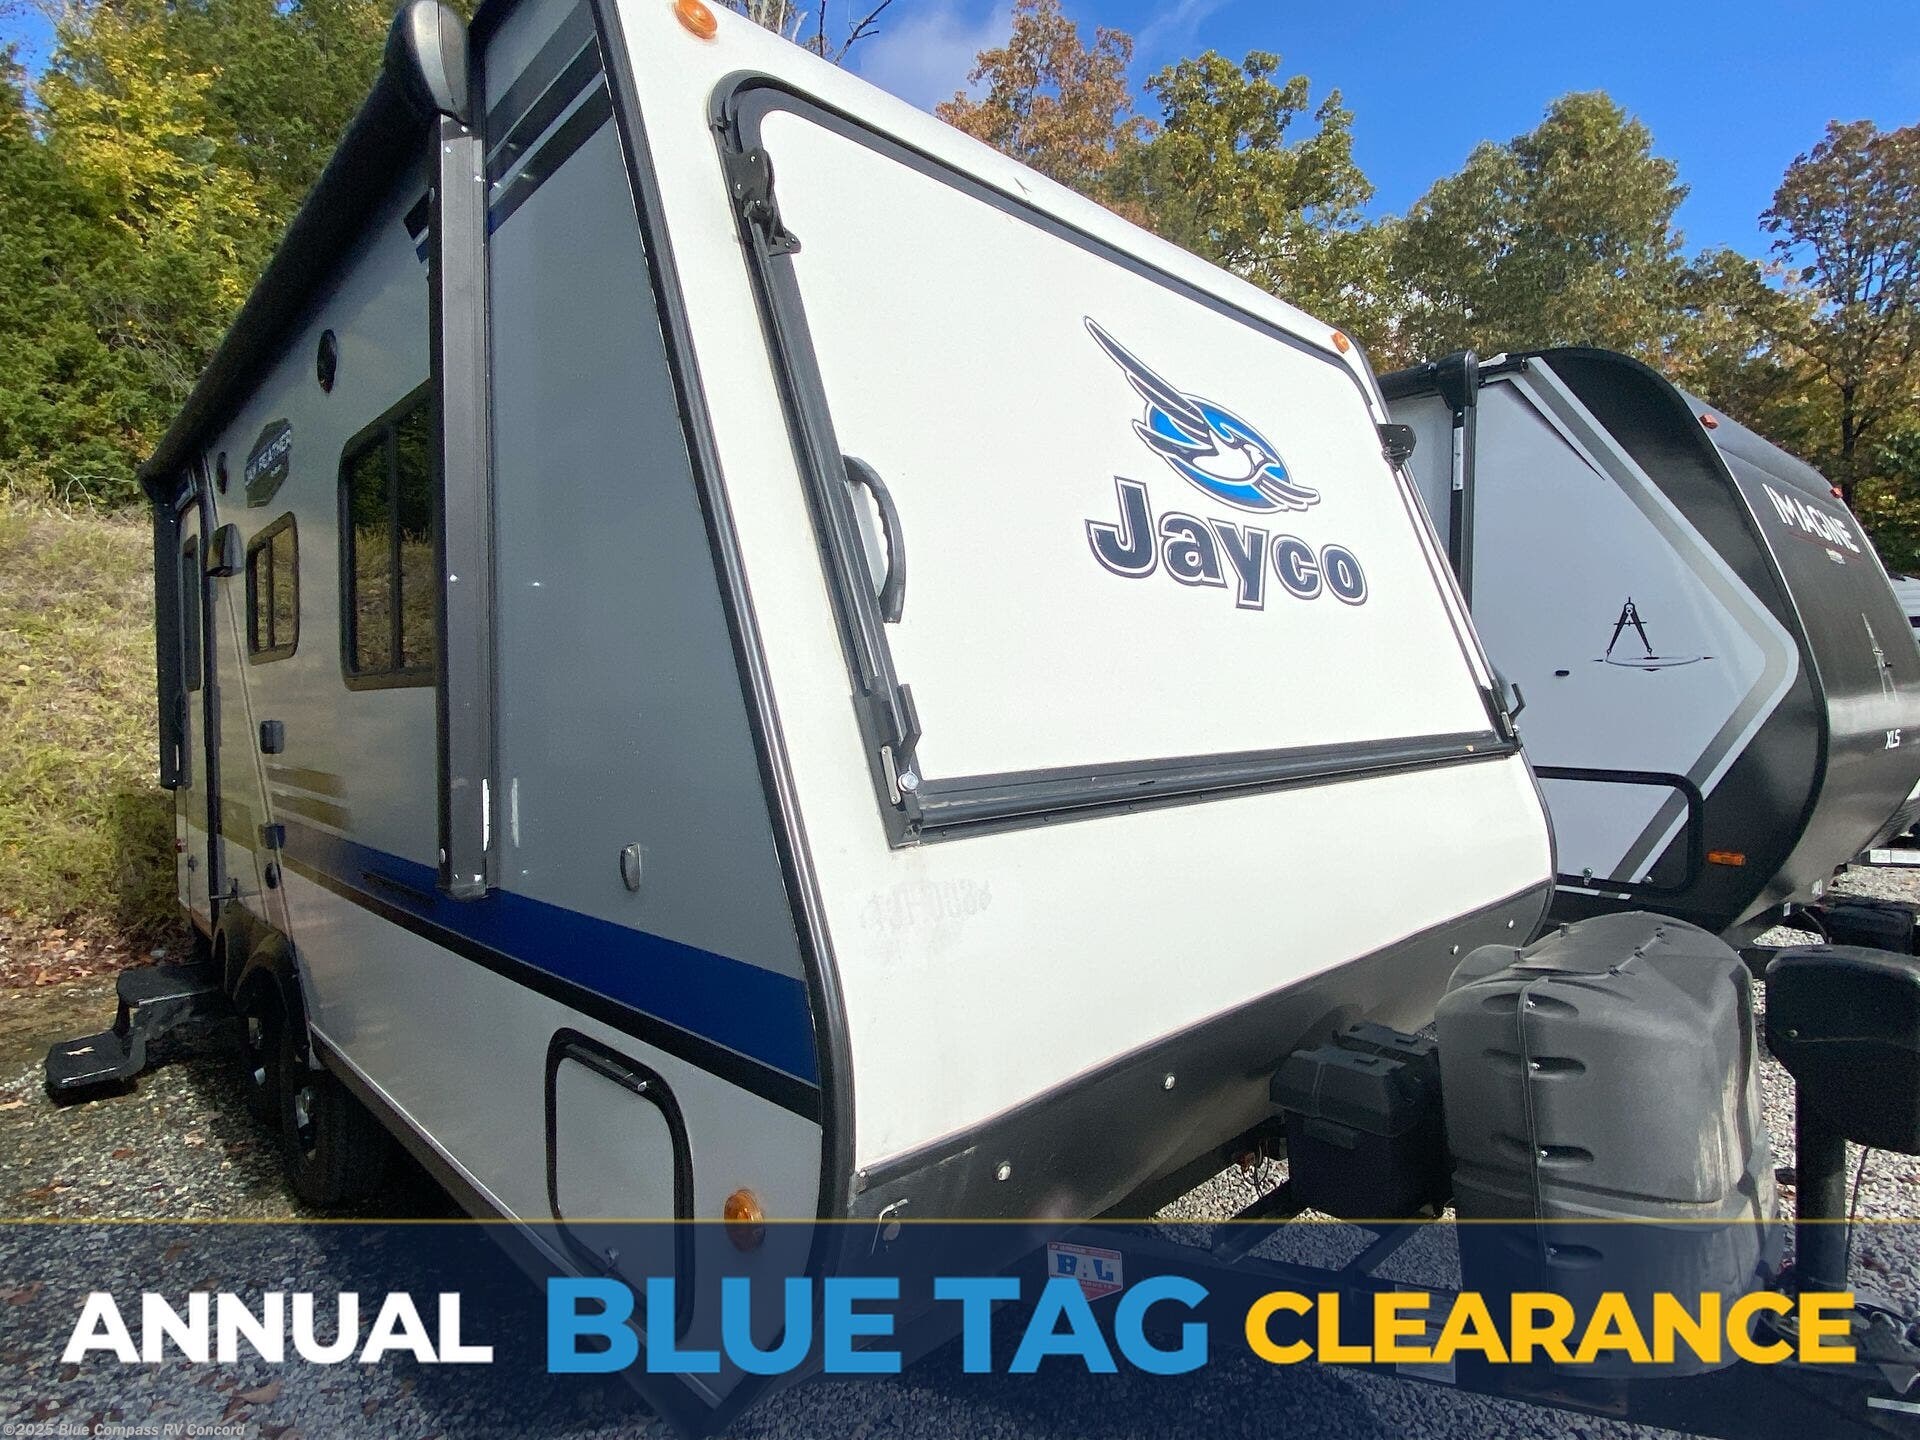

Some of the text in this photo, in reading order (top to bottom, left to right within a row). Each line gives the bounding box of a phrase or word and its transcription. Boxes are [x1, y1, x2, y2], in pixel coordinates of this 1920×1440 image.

[1085, 476, 1367, 610] Jayco
[1762, 483, 1860, 553] IMAGINE
[1885, 728, 1901, 749] XLS
